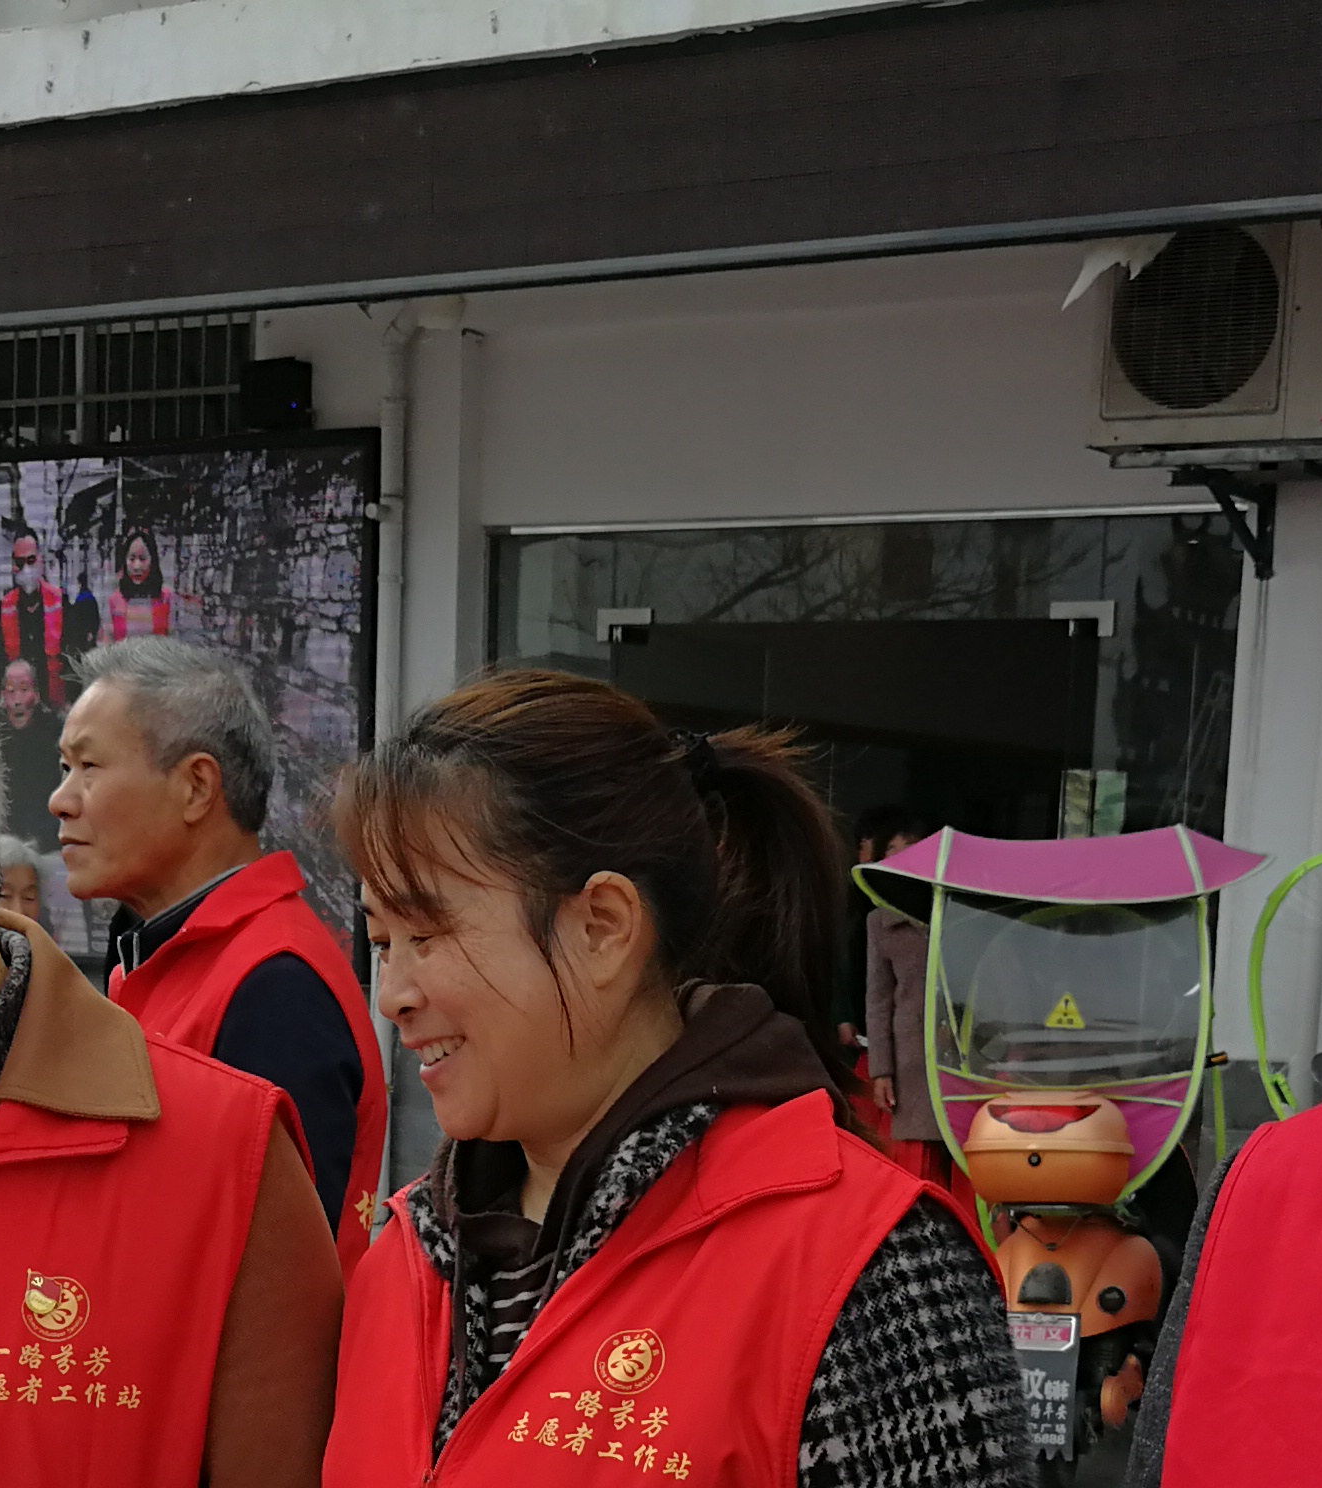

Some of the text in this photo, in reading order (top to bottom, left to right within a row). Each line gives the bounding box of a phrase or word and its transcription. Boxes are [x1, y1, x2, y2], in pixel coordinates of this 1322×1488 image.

[549, 1390, 669, 1438] 一路芬芳
[508, 1411, 692, 1480] 志愿者工作站
